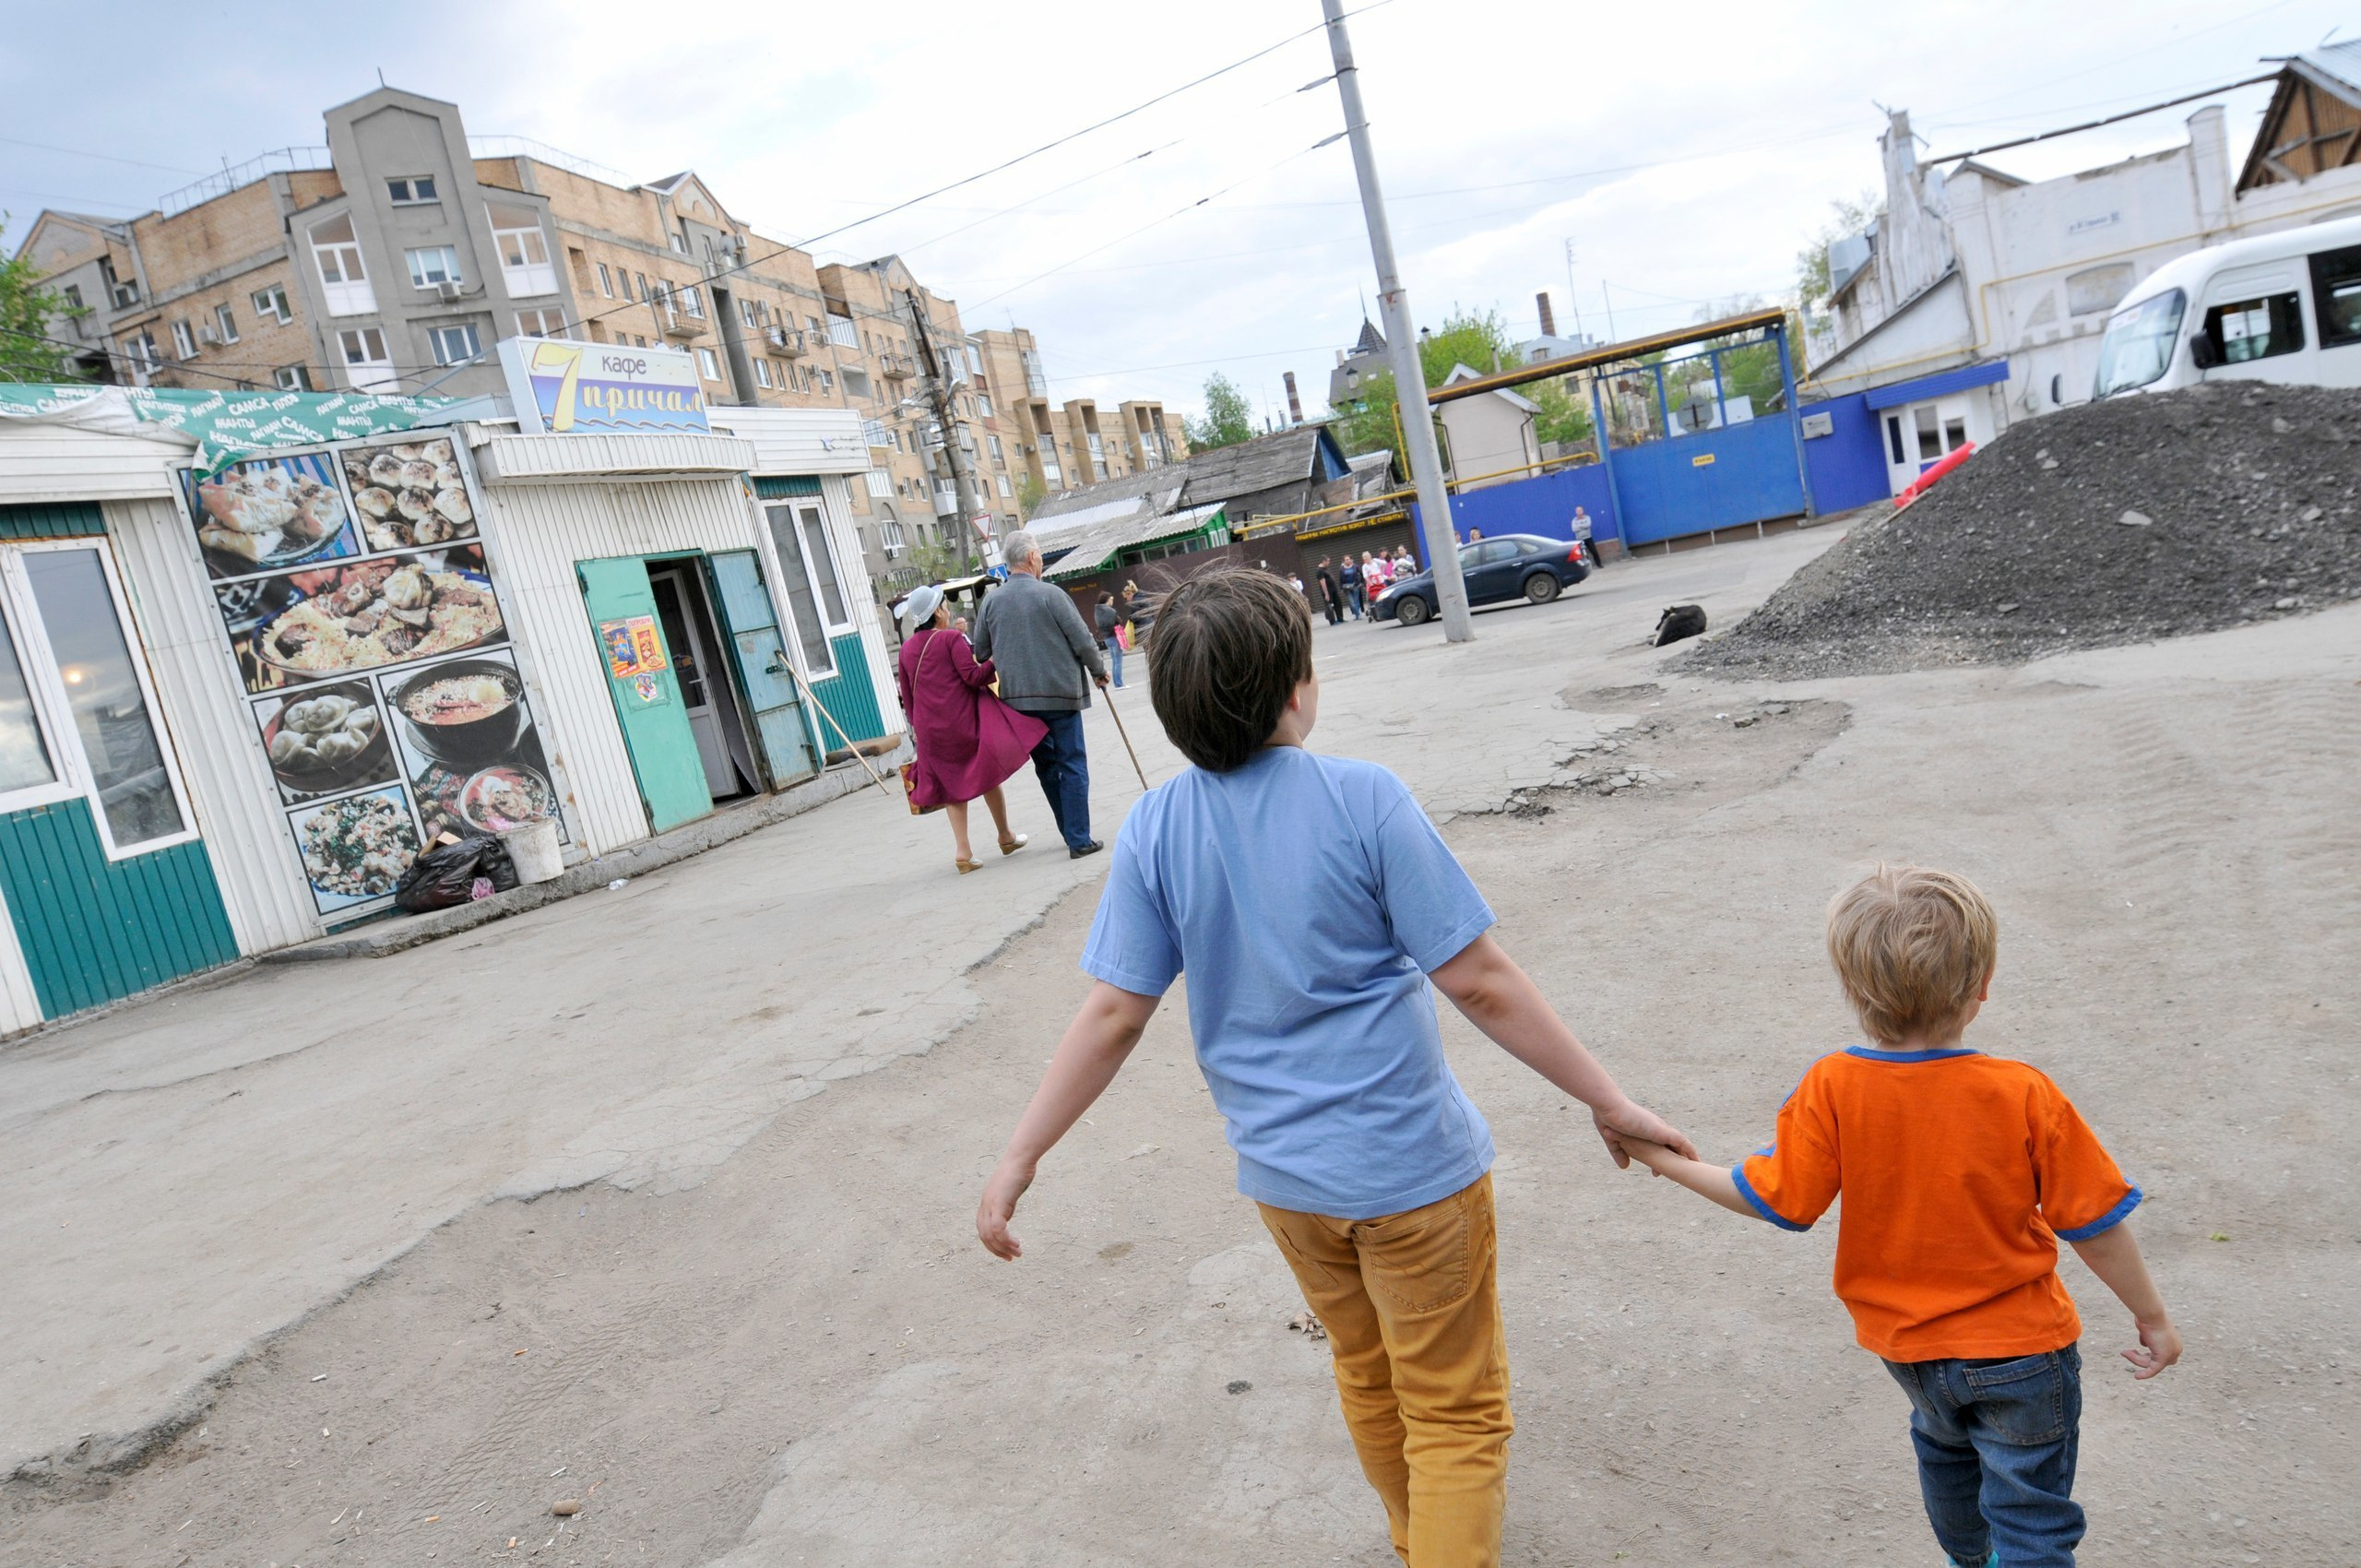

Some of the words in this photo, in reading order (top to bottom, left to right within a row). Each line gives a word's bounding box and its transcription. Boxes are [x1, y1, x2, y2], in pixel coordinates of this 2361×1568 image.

[602, 356, 647, 380] кафе
[531, 342, 583, 432] 7
[583, 385, 704, 418] причал
[190, 397, 226, 418] ЛАГМАН
[228, 397, 271, 415] САМСА
[271, 393, 300, 411] ПЛОВ
[348, 399, 379, 415] САМСА
[214, 418, 257, 429] МАНТЫ
[250, 420, 283, 442] ЛАГМАН
[281, 416, 325, 442] САМСА
[336, 416, 374, 427] МАНТЫ
